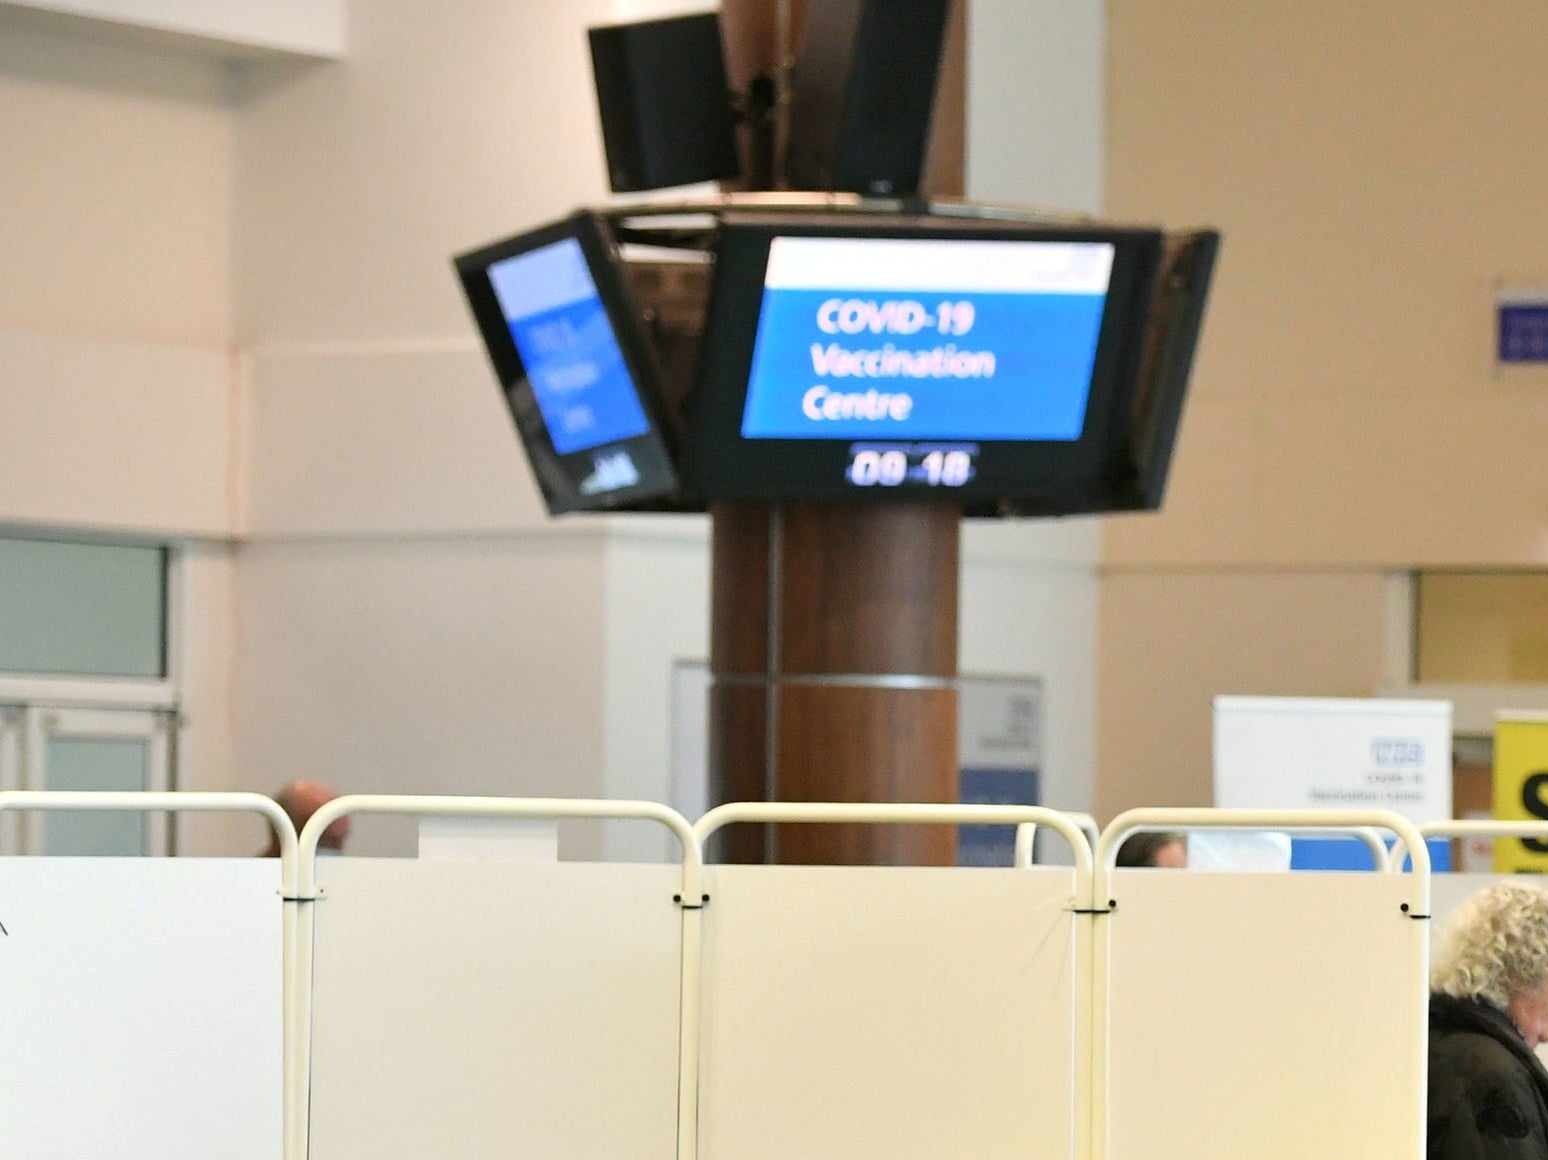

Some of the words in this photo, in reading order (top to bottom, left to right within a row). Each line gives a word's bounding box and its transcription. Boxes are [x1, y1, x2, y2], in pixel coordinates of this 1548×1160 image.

[816, 301, 975, 336] COVID-19
[811, 343, 995, 379] Vaccination
[802, 386, 912, 422] Centre
